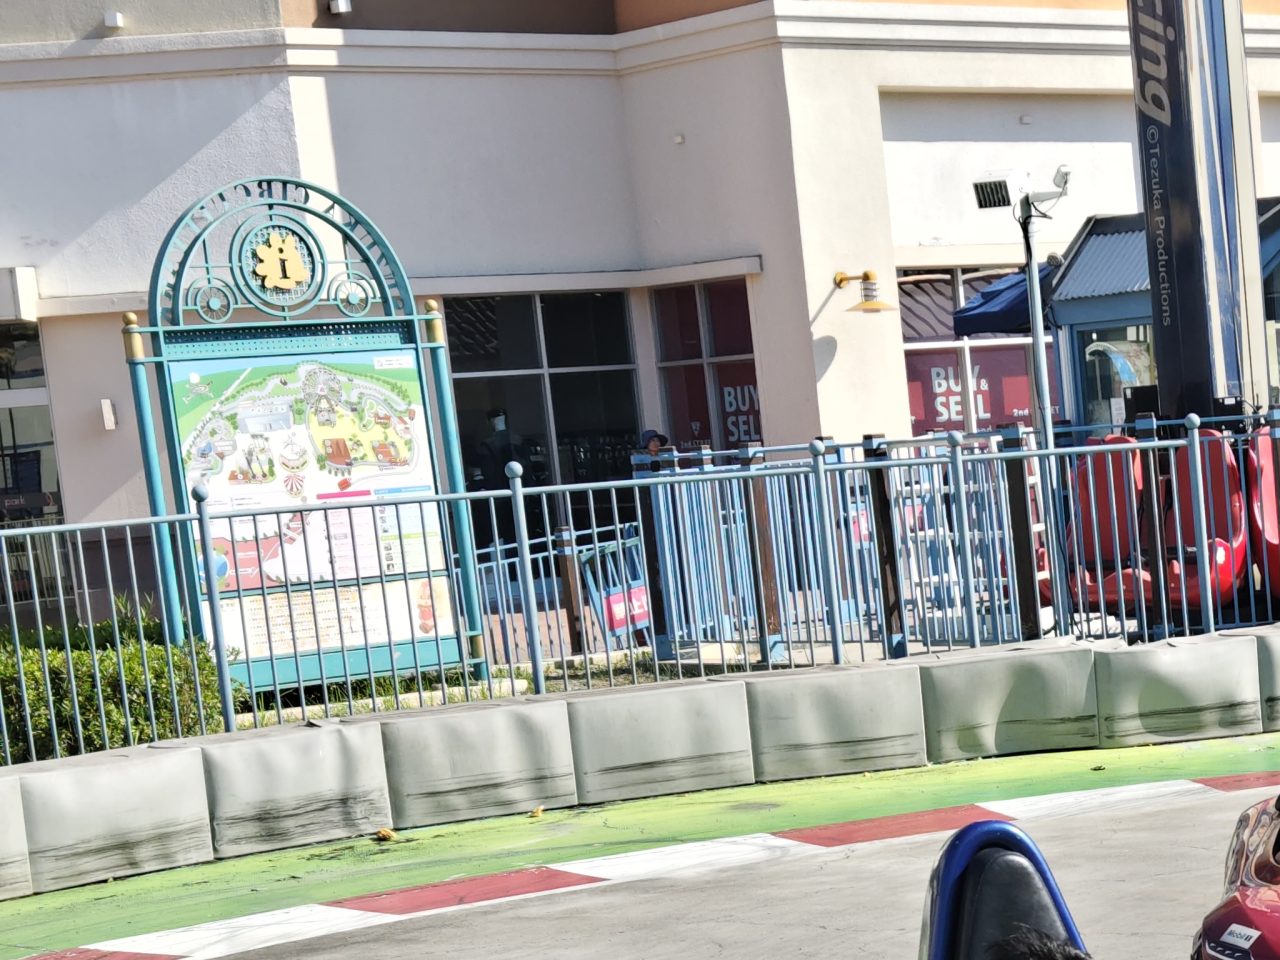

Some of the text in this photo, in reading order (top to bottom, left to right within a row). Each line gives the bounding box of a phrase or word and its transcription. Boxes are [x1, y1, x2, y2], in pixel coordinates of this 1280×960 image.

[1135, 0, 1176, 127] ing
[1154, 216, 1171, 326] Productions
[934, 394, 991, 423] SEL
[1013, 407, 1029, 417] 2nd
[727, 415, 762, 442] SEL
[1226, 929, 1246, 940] Mobil
